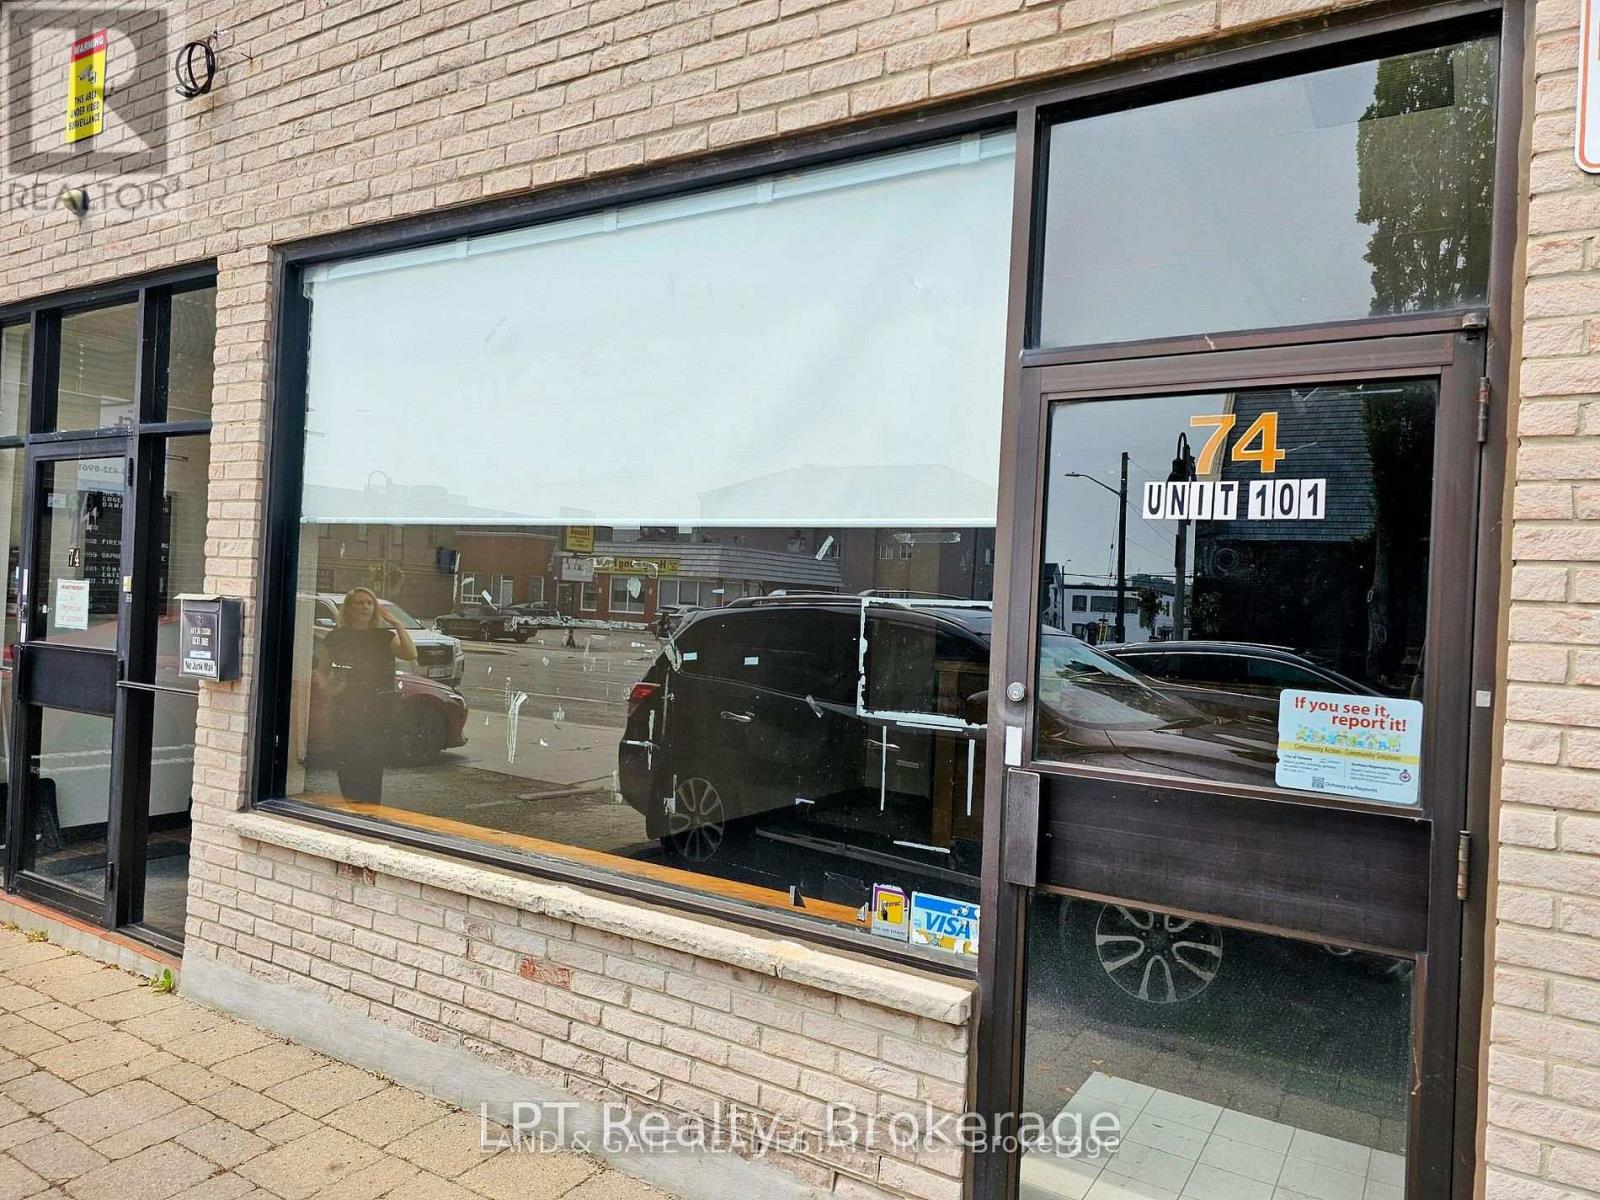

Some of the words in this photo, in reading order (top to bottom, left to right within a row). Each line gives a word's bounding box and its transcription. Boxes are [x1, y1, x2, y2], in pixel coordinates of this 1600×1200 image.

[85, 89, 97, 100] AREA
[86, 101, 99, 113] VIDEO
[1190, 411, 1286, 475] 74
[1147, 483, 1234, 516] UNIT
[1255, 483, 1319, 517] 101
[69, 548, 80, 567] 74
[1295, 696, 1306, 709] If
[1309, 701, 1339, 713] you
[1343, 704, 1370, 715] see
[1374, 704, 1390, 719] it,
[1332, 715, 1385, 730] report
[1389, 718, 1407, 732] it!
[925, 911, 971, 940] VISA
